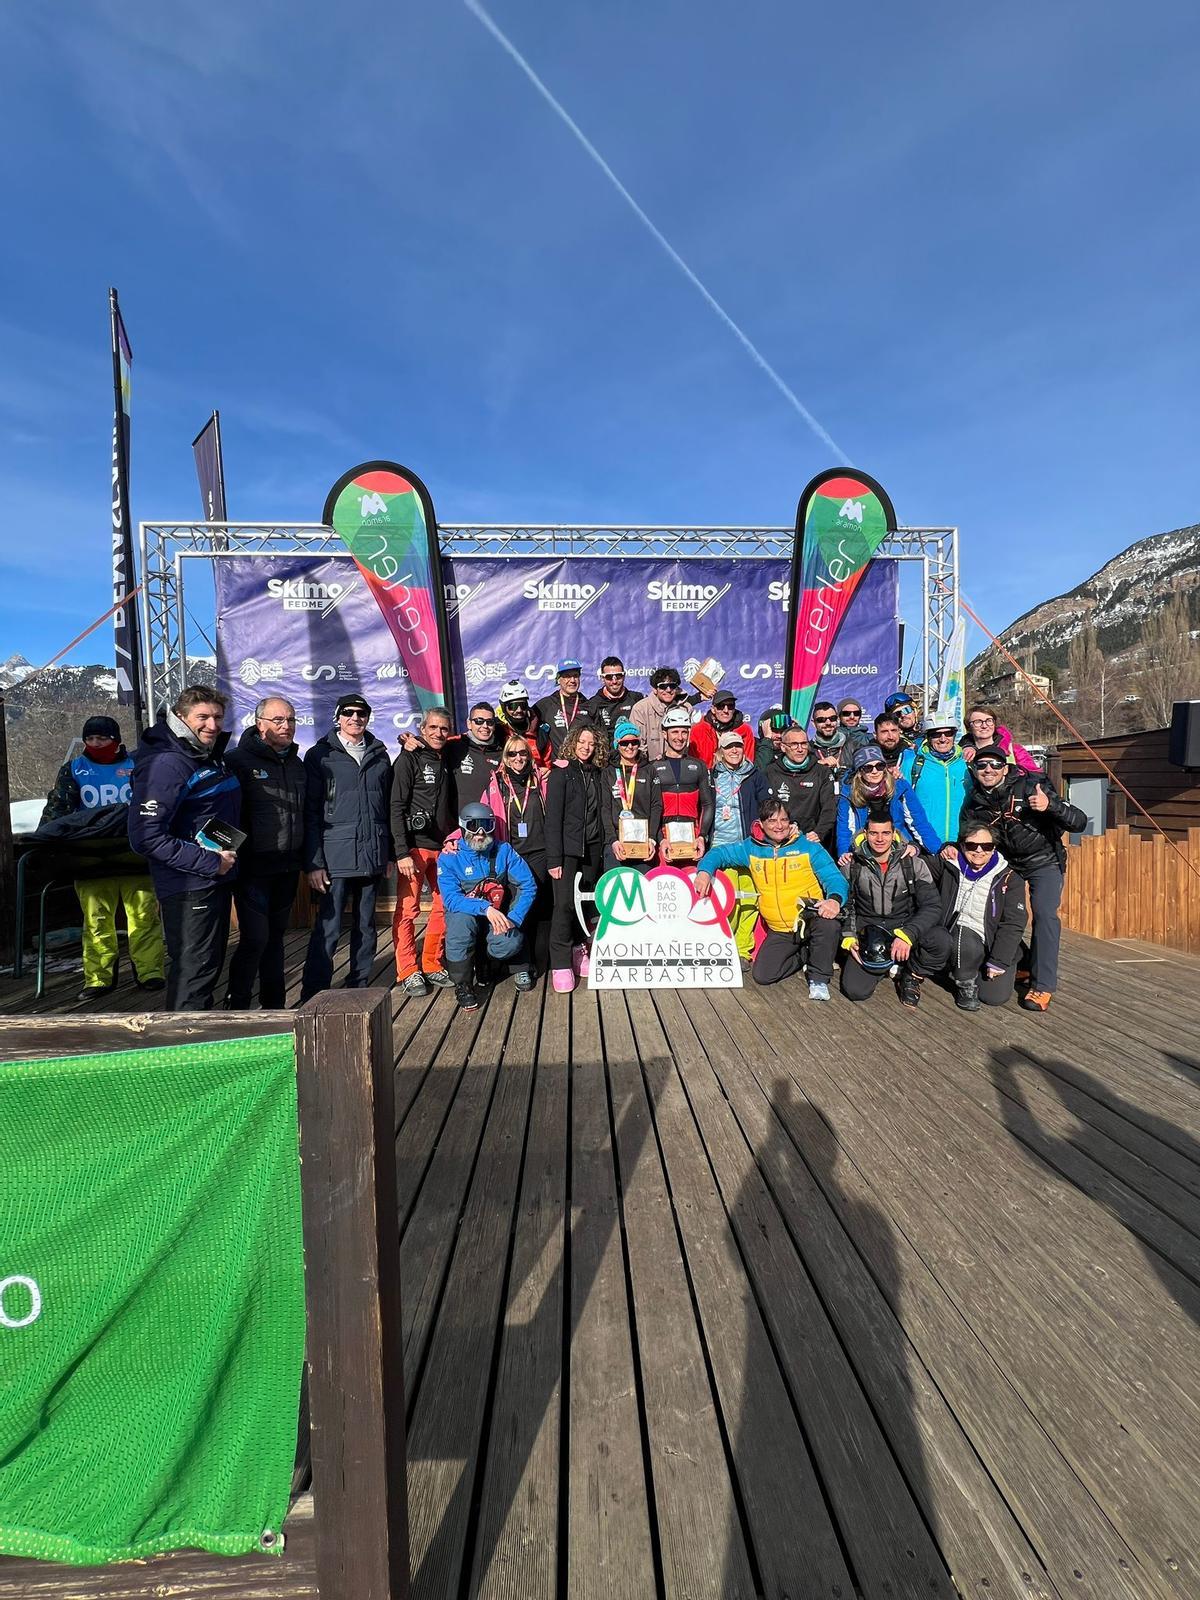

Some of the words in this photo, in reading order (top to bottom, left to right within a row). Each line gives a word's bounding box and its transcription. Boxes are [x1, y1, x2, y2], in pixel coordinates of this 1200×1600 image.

[267, 579, 343, 599] Skimo
[523, 580, 595, 600] Skimo
[647, 580, 718, 601] Skimo
[804, 539, 856, 655] cerler
[543, 602, 576, 610] FEDME
[666, 602, 699, 610] FEDME
[831, 664, 878, 675] Iberdrola
[657, 881, 676, 891] BAR
[657, 892, 677, 901] BAS
[656, 903, 677, 912] TRO
[596, 940, 733, 957] MONTAÑEROS
[595, 967, 734, 983] BARBASTRO
